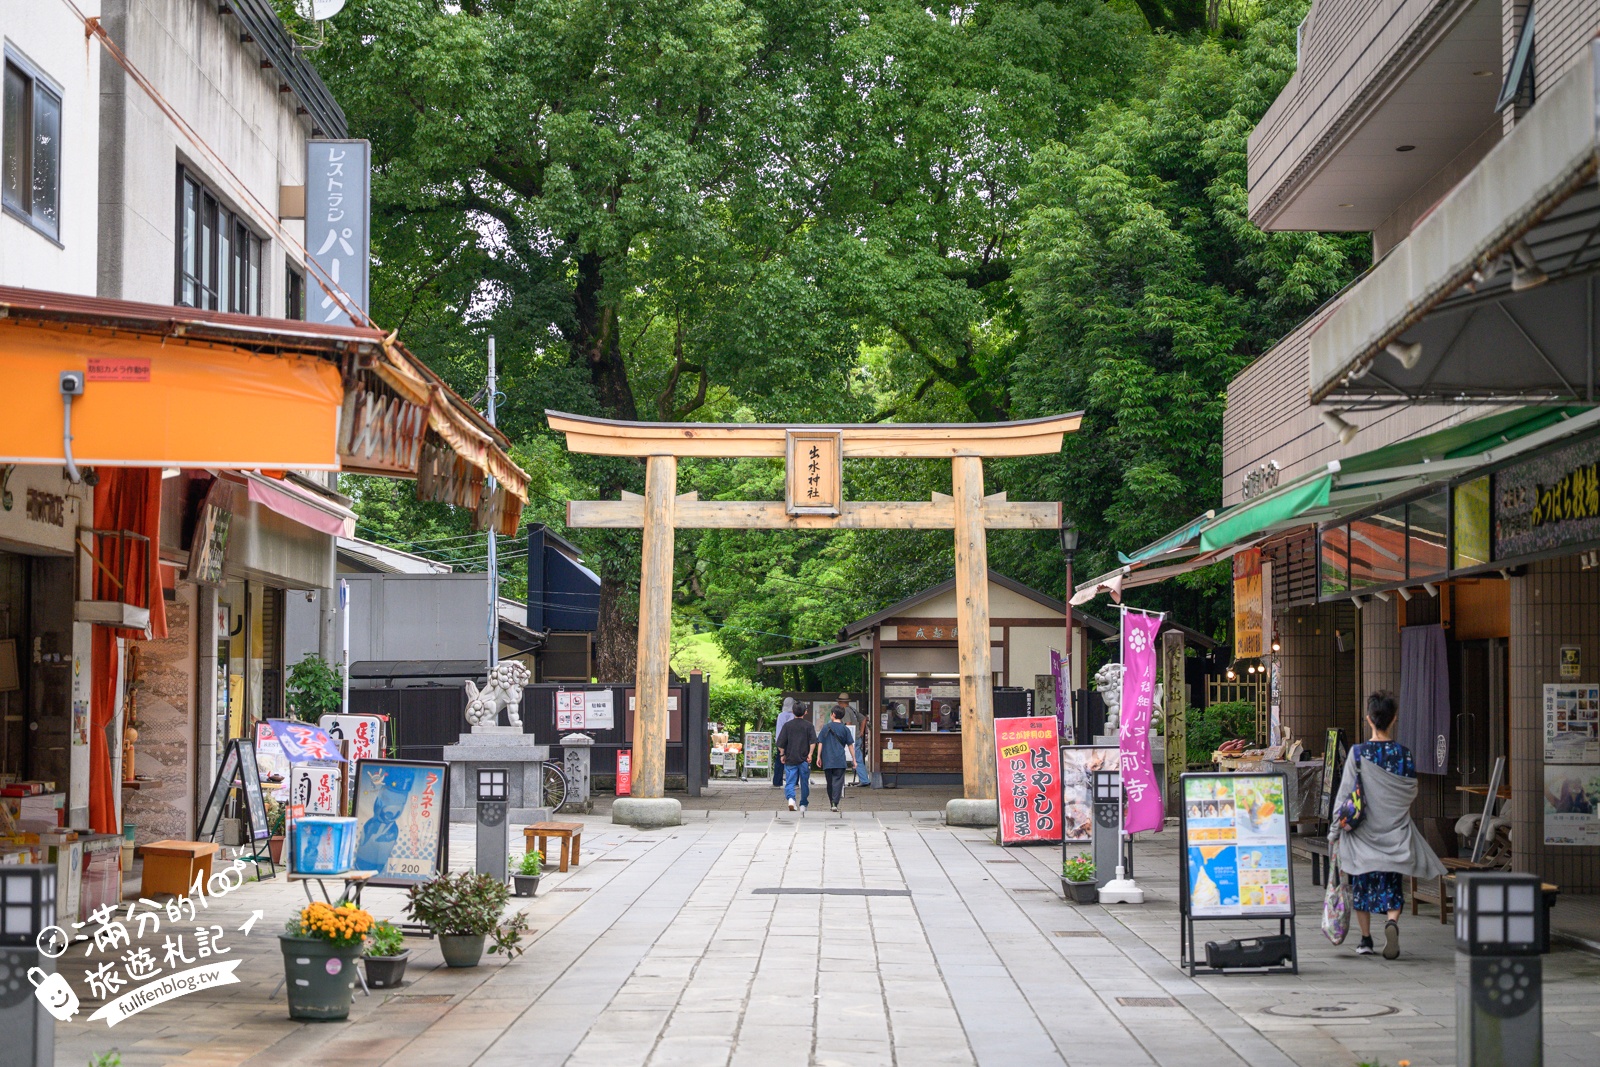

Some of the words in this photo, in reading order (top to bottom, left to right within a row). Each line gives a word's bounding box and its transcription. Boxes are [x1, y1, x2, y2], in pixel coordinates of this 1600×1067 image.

[327, 147, 345, 222] レストラン
[316, 227, 354, 322] パーク
[807, 445, 820, 499] 出水神社
[1532, 462, 1599, 526] みつばち牧場
[285, 725, 334, 760] ラムネ
[1001, 729, 1053, 740] ここが評判の店
[1003, 742, 1028, 757] 究極の
[1119, 719, 1149, 803] 水前寺
[420, 771, 439, 819] ラムネの
[1010, 759, 1031, 836] いきなり団子
[1030, 747, 1054, 831] はやしの
[401, 863, 420, 873] 200
